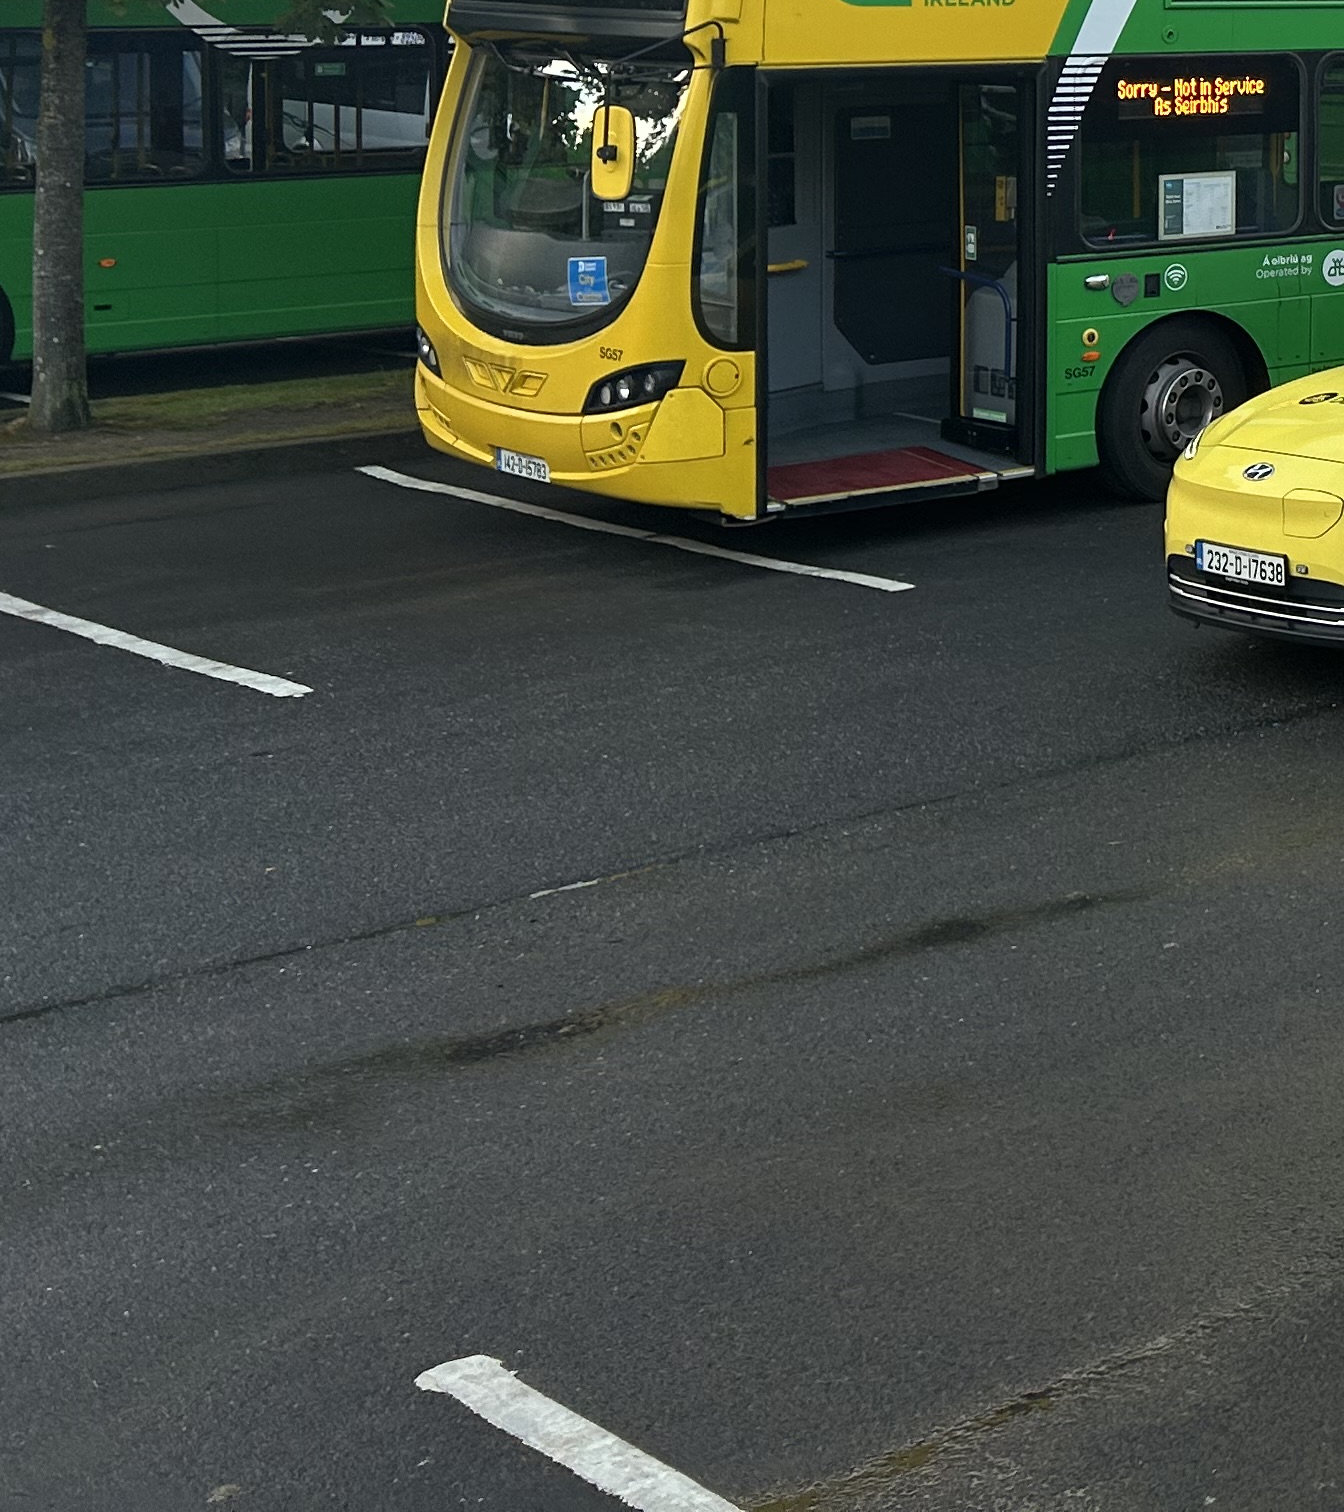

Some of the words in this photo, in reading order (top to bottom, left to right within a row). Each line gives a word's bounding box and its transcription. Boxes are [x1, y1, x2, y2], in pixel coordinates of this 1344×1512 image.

[1118, 80, 1158, 99] Sorry
[1174, 78, 1197, 97] Not
[1200, 78, 1211, 96] in
[1215, 76, 1265, 96] Service
[1154, 97, 1171, 116] As
[1256, 267, 1299, 279] Operated
[1301, 265, 1312, 276] by
[600, 346, 624, 361] SG57
[1064, 366, 1096, 380] SG57
[1207, 549, 1283, 583] 232-D-17638
